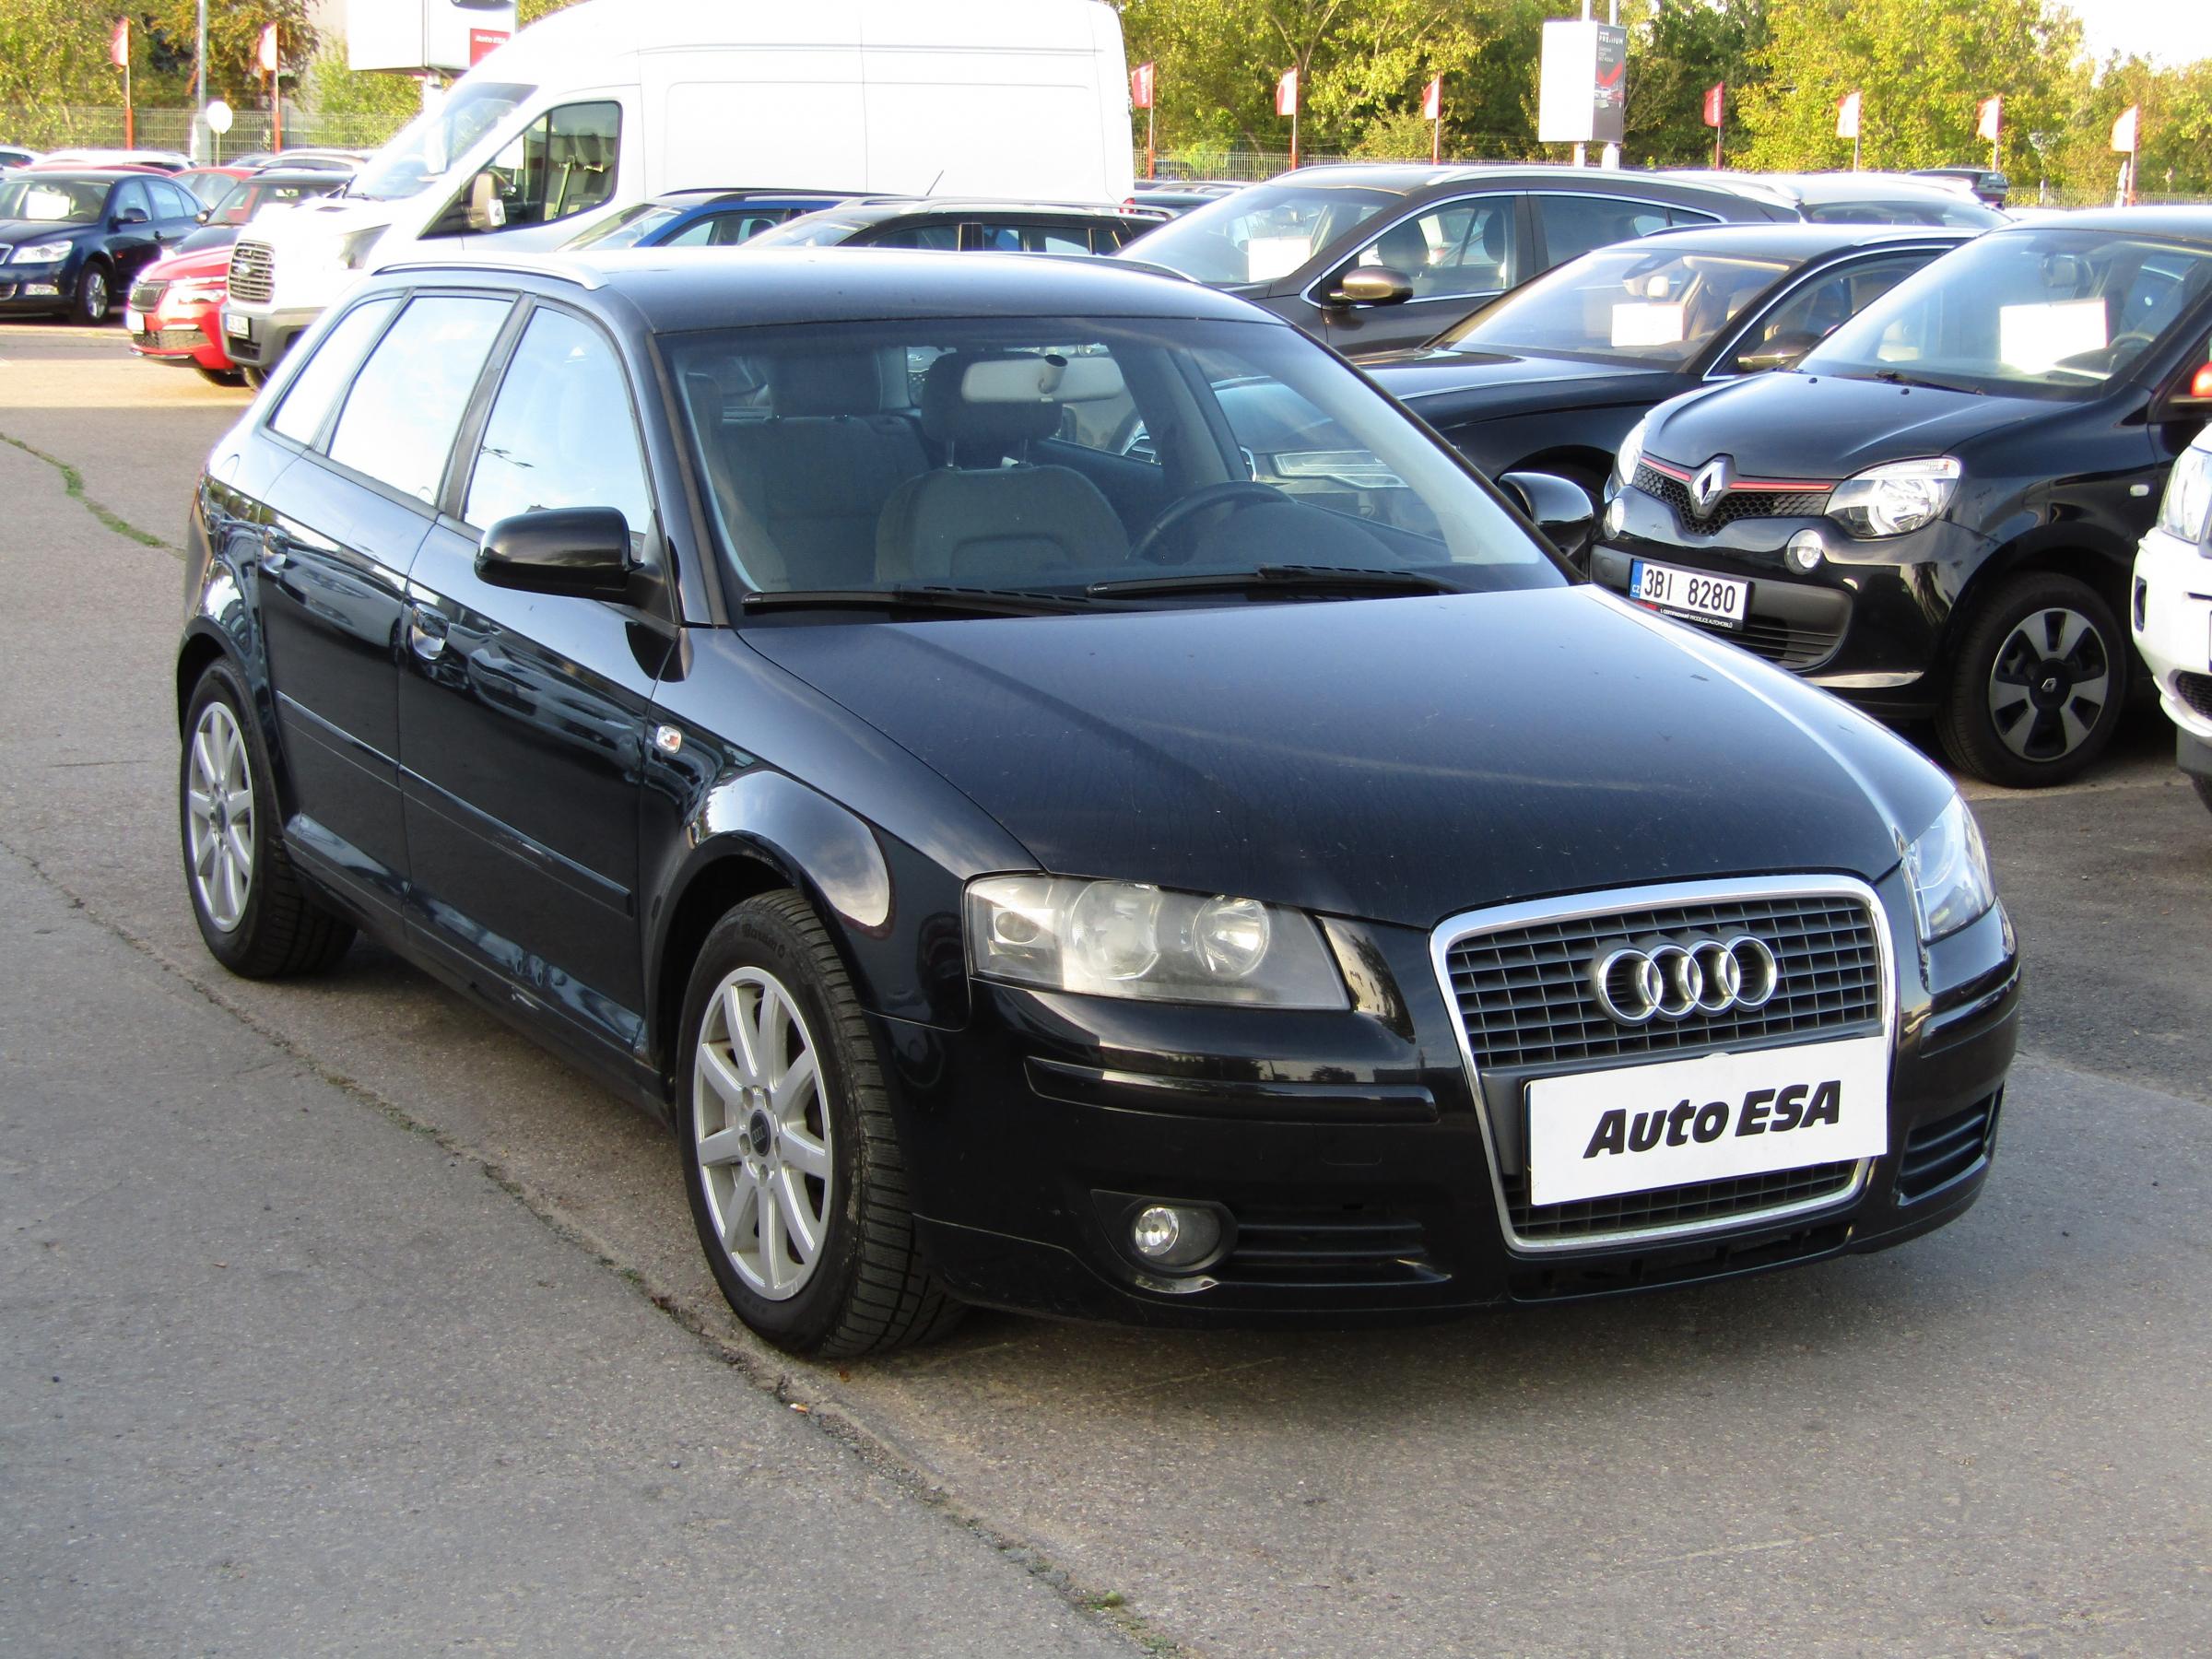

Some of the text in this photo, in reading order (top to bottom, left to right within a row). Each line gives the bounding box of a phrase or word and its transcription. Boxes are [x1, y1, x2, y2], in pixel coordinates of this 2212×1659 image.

[1631, 584, 1640, 594] CZ
[1688, 578, 1735, 613] 8280
[1583, 1080, 1841, 1159] Auto ESA
